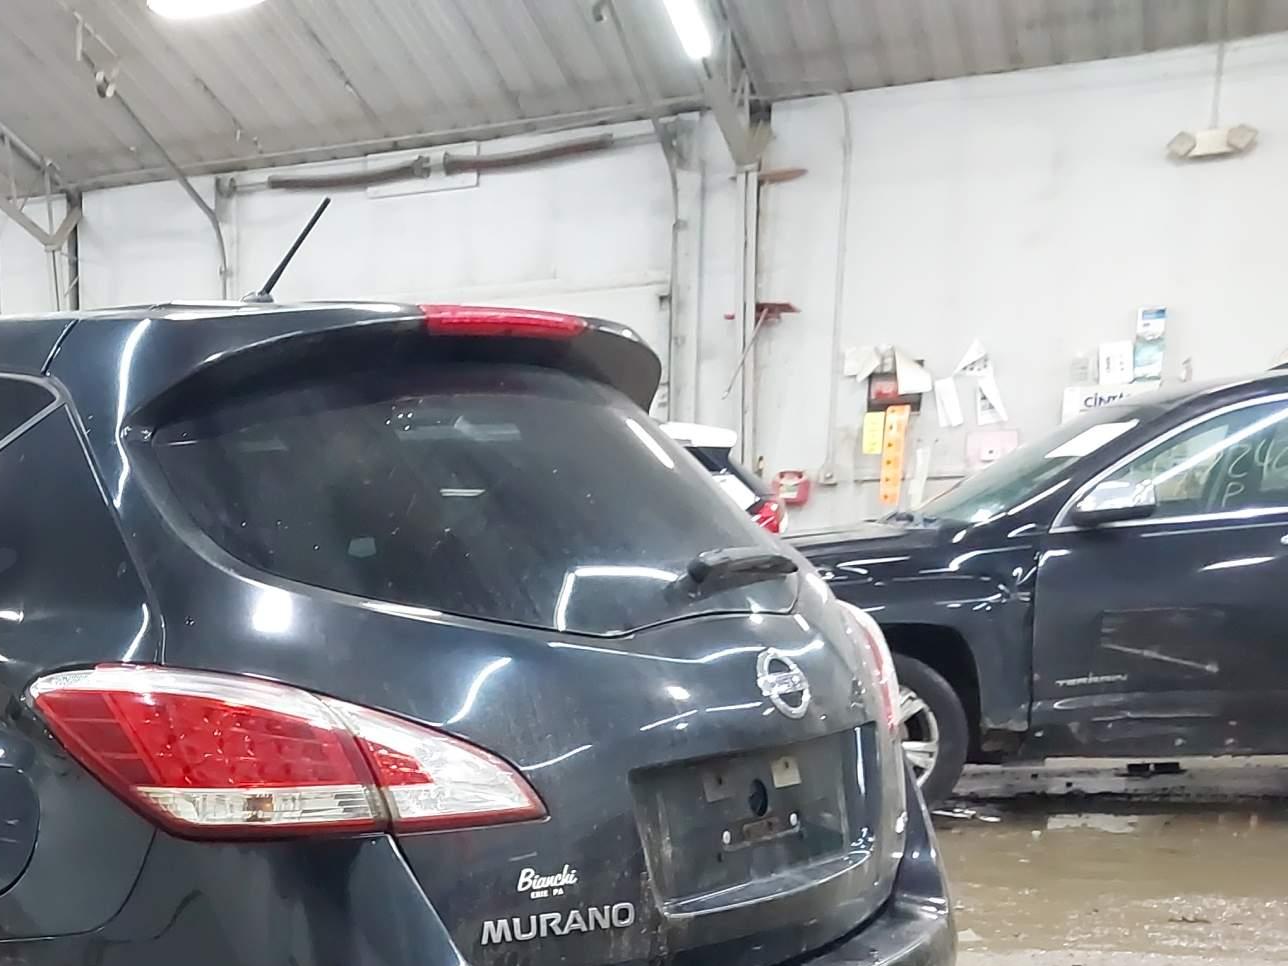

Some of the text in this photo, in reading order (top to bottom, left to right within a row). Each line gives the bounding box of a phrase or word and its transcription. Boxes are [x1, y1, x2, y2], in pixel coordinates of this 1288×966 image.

[517, 864, 579, 892] Bianchi
[552, 887, 564, 897] PA
[481, 902, 635, 945] MURANO
